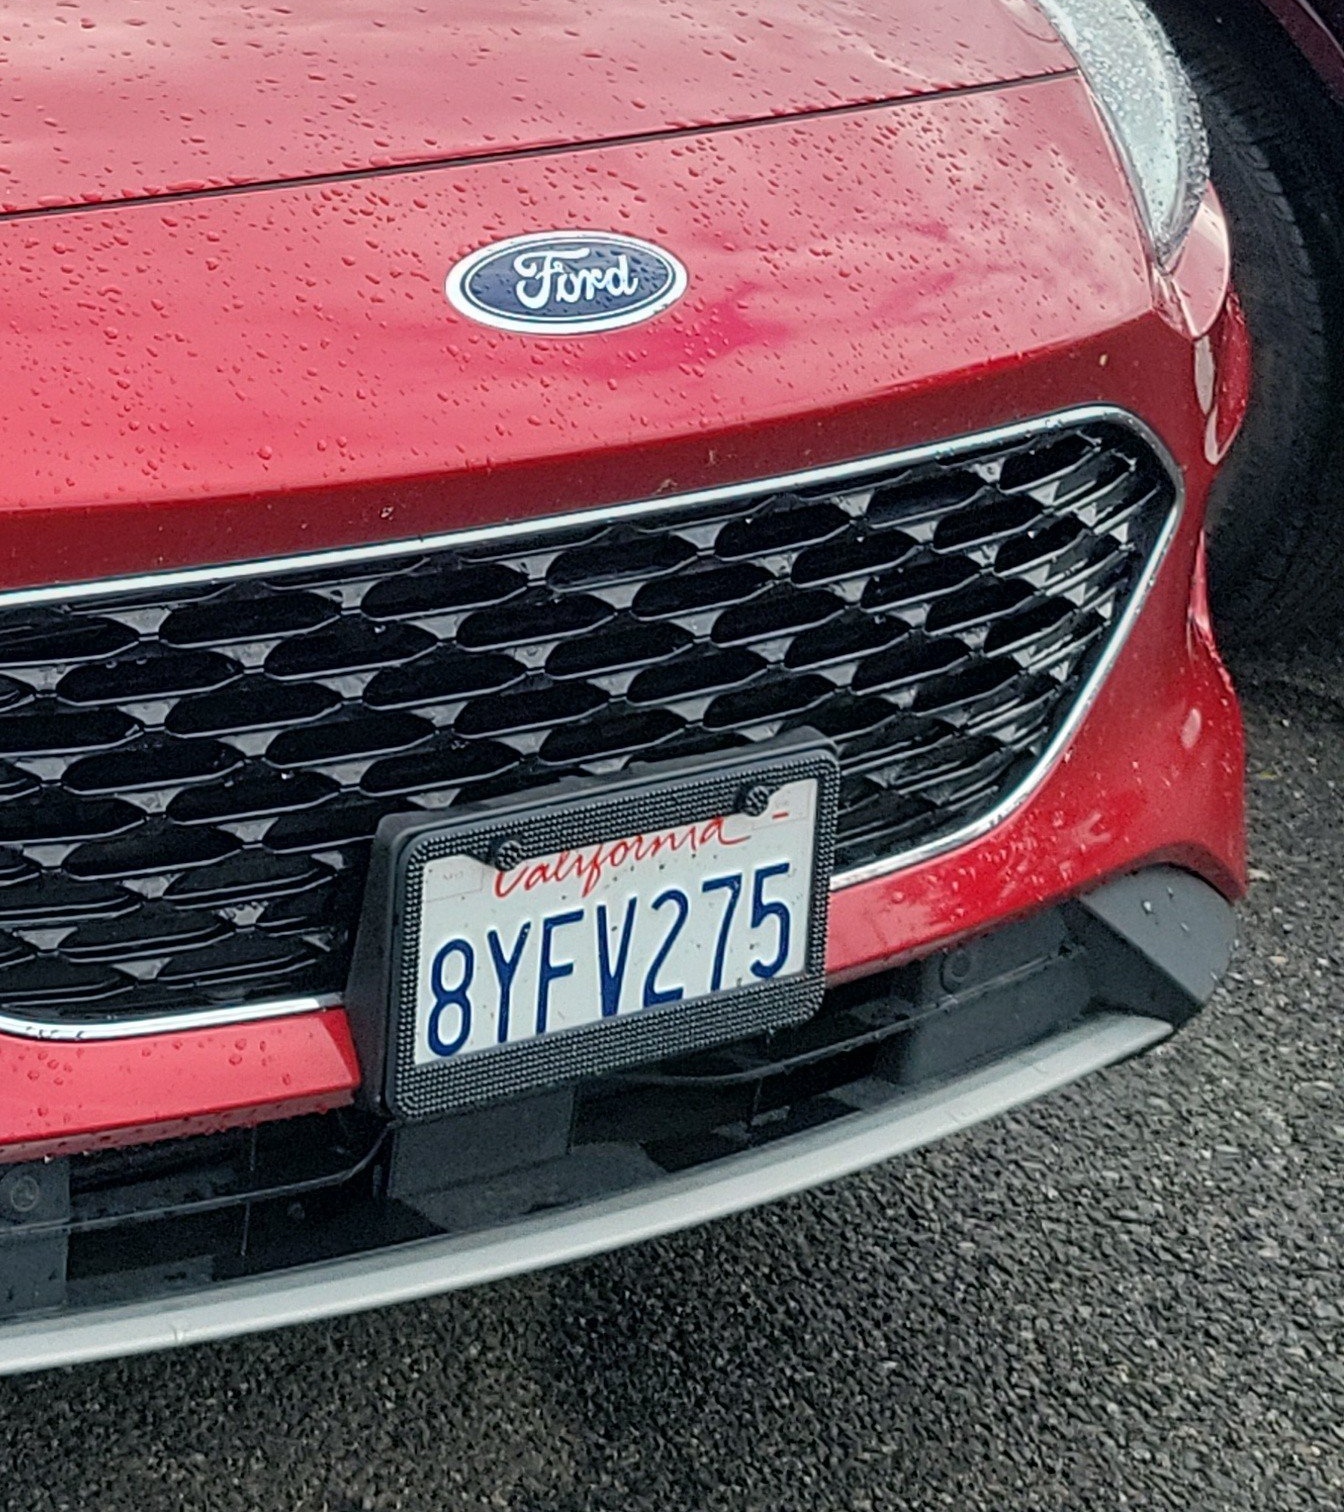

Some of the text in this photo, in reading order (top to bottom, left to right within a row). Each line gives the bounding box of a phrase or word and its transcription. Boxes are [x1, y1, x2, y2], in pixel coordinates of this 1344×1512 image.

[513, 247, 639, 309] Ford
[494, 814, 751, 897] California
[427, 862, 791, 1057] 8YFV275
